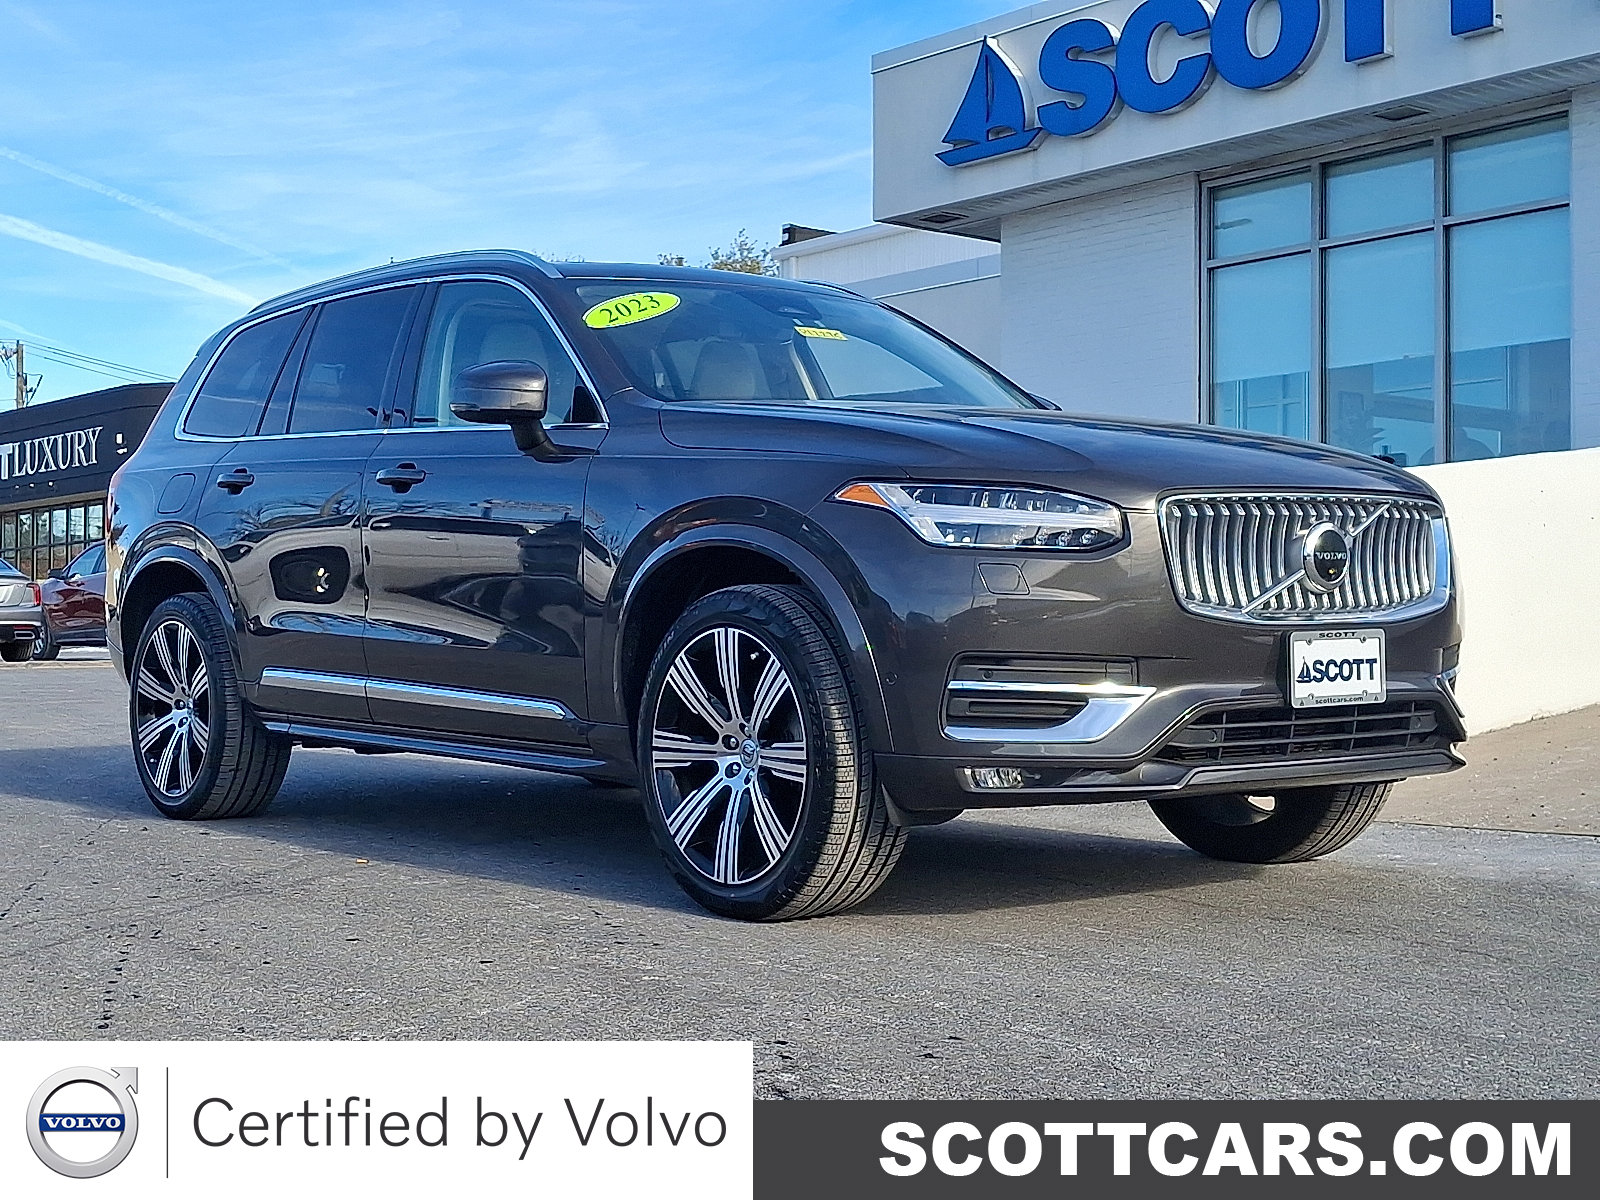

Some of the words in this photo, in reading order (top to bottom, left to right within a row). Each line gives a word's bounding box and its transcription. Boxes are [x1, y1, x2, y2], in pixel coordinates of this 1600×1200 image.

[600, 295, 660, 323] 2023
[12, 426, 103, 477] LUXURY
[1315, 551, 1347, 560] VOLVO
[1315, 696, 1364, 704] scottcars.com
